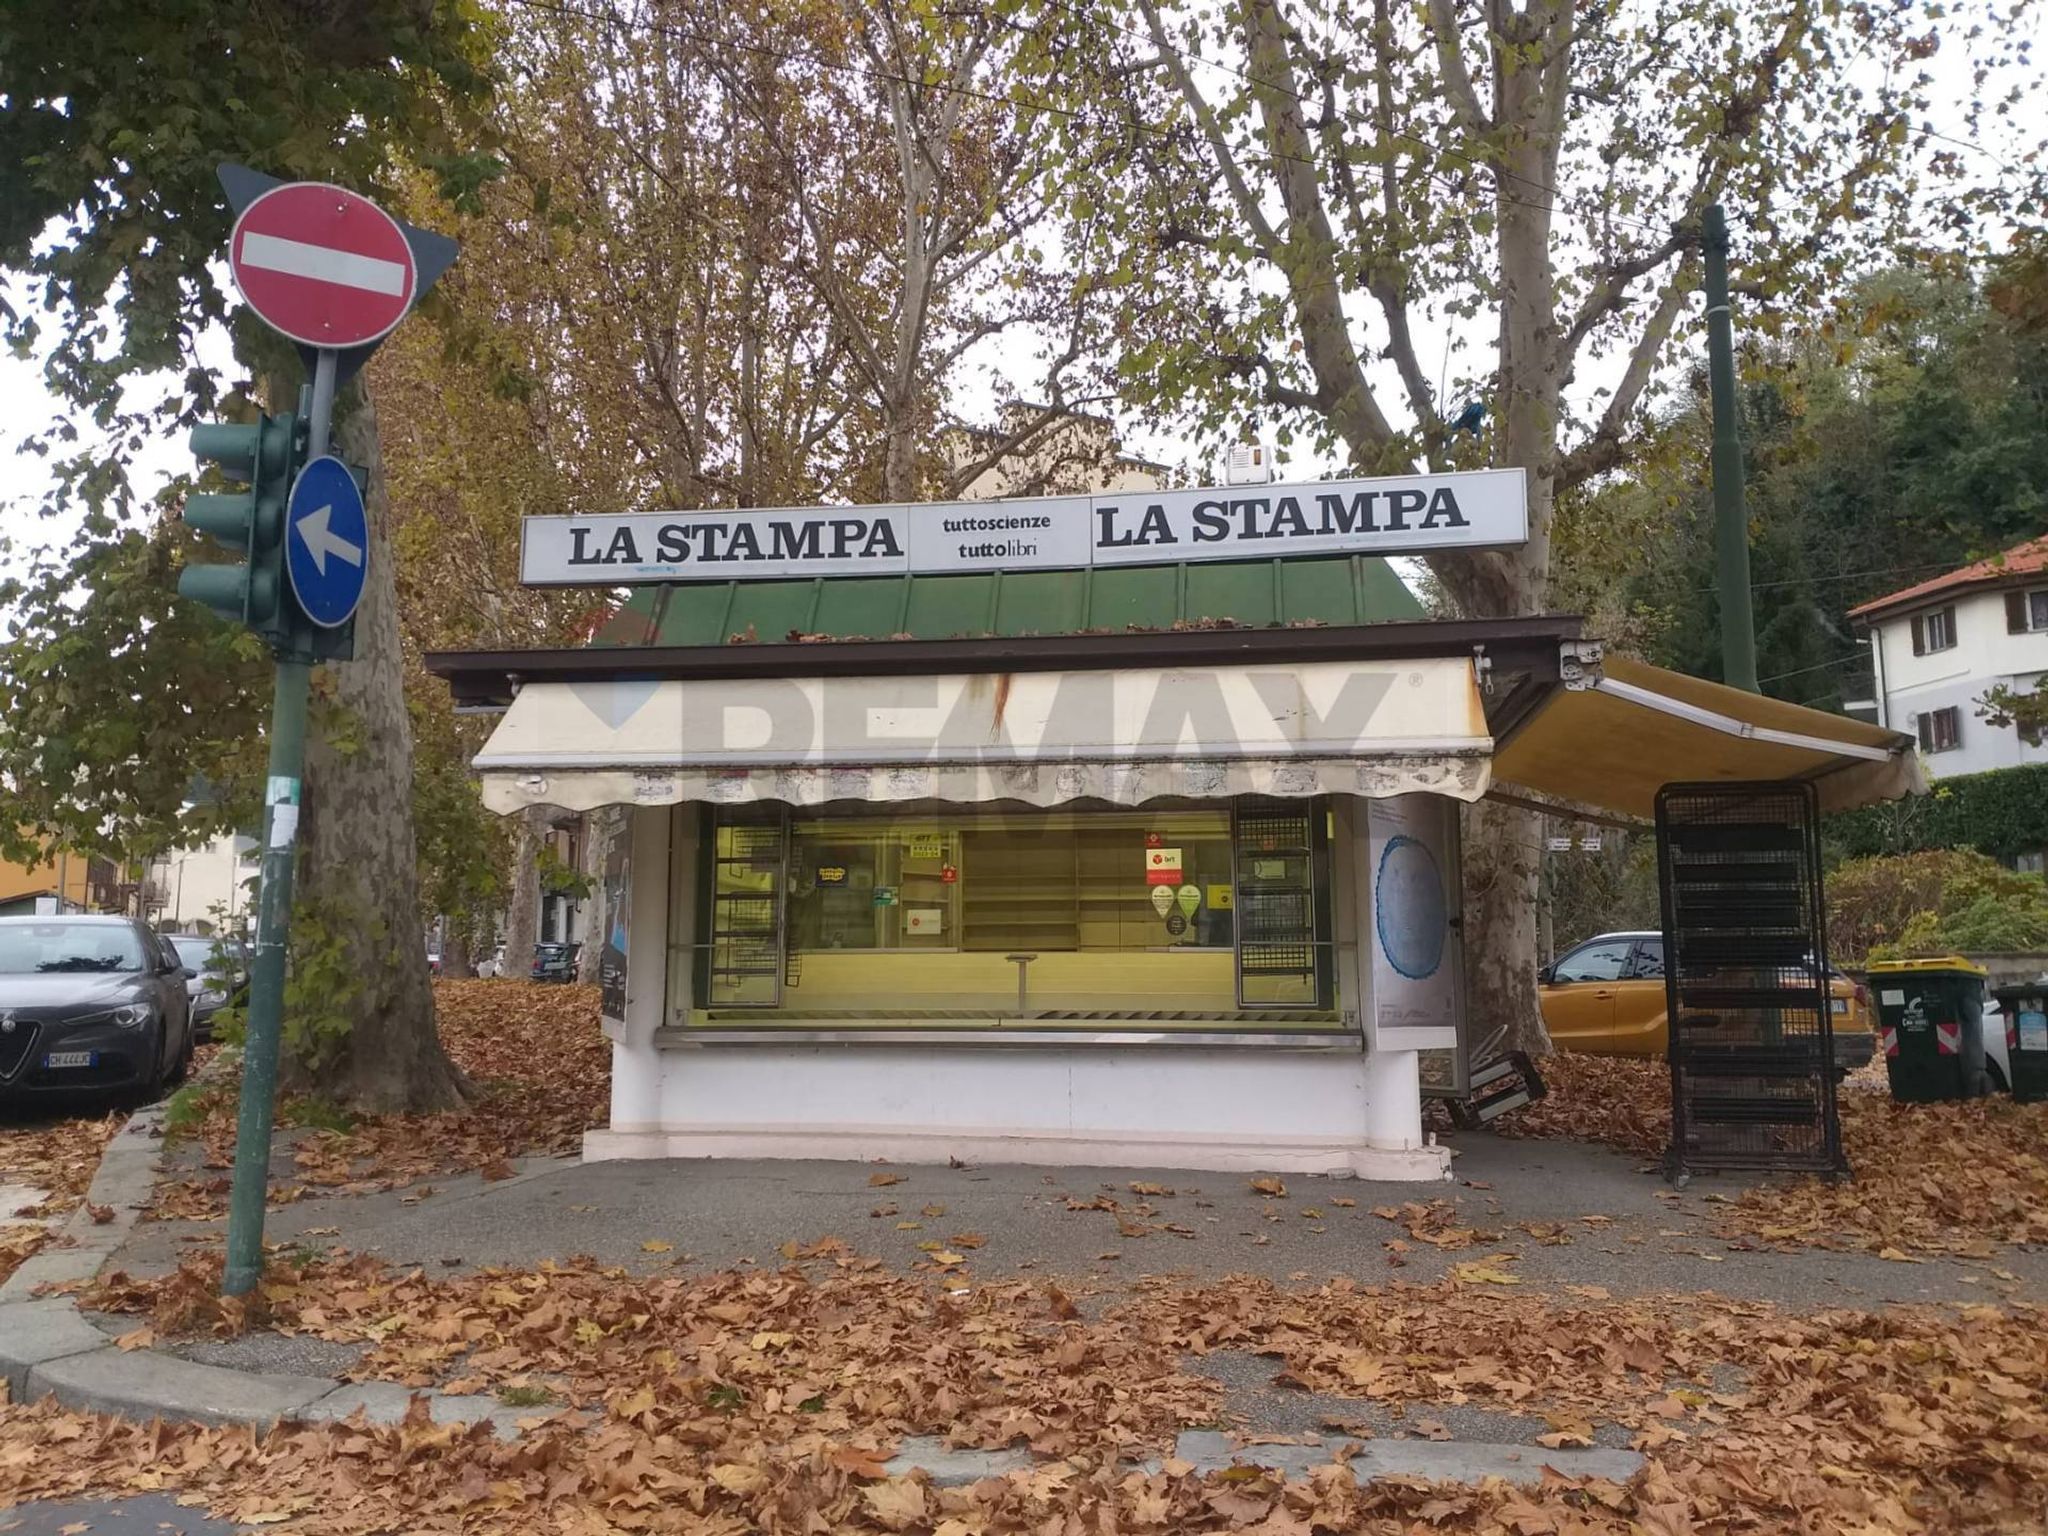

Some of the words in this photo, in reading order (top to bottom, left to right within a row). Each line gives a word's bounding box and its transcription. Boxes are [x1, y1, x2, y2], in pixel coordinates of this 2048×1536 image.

[942, 515, 1051, 533] tuttoscienze
[1096, 504, 1178, 548] LA
[1192, 487, 1470, 542] STAMPA
[568, 526, 642, 565] LA
[656, 518, 905, 564] STAMPA
[958, 538, 1037, 558] tuttolibri
